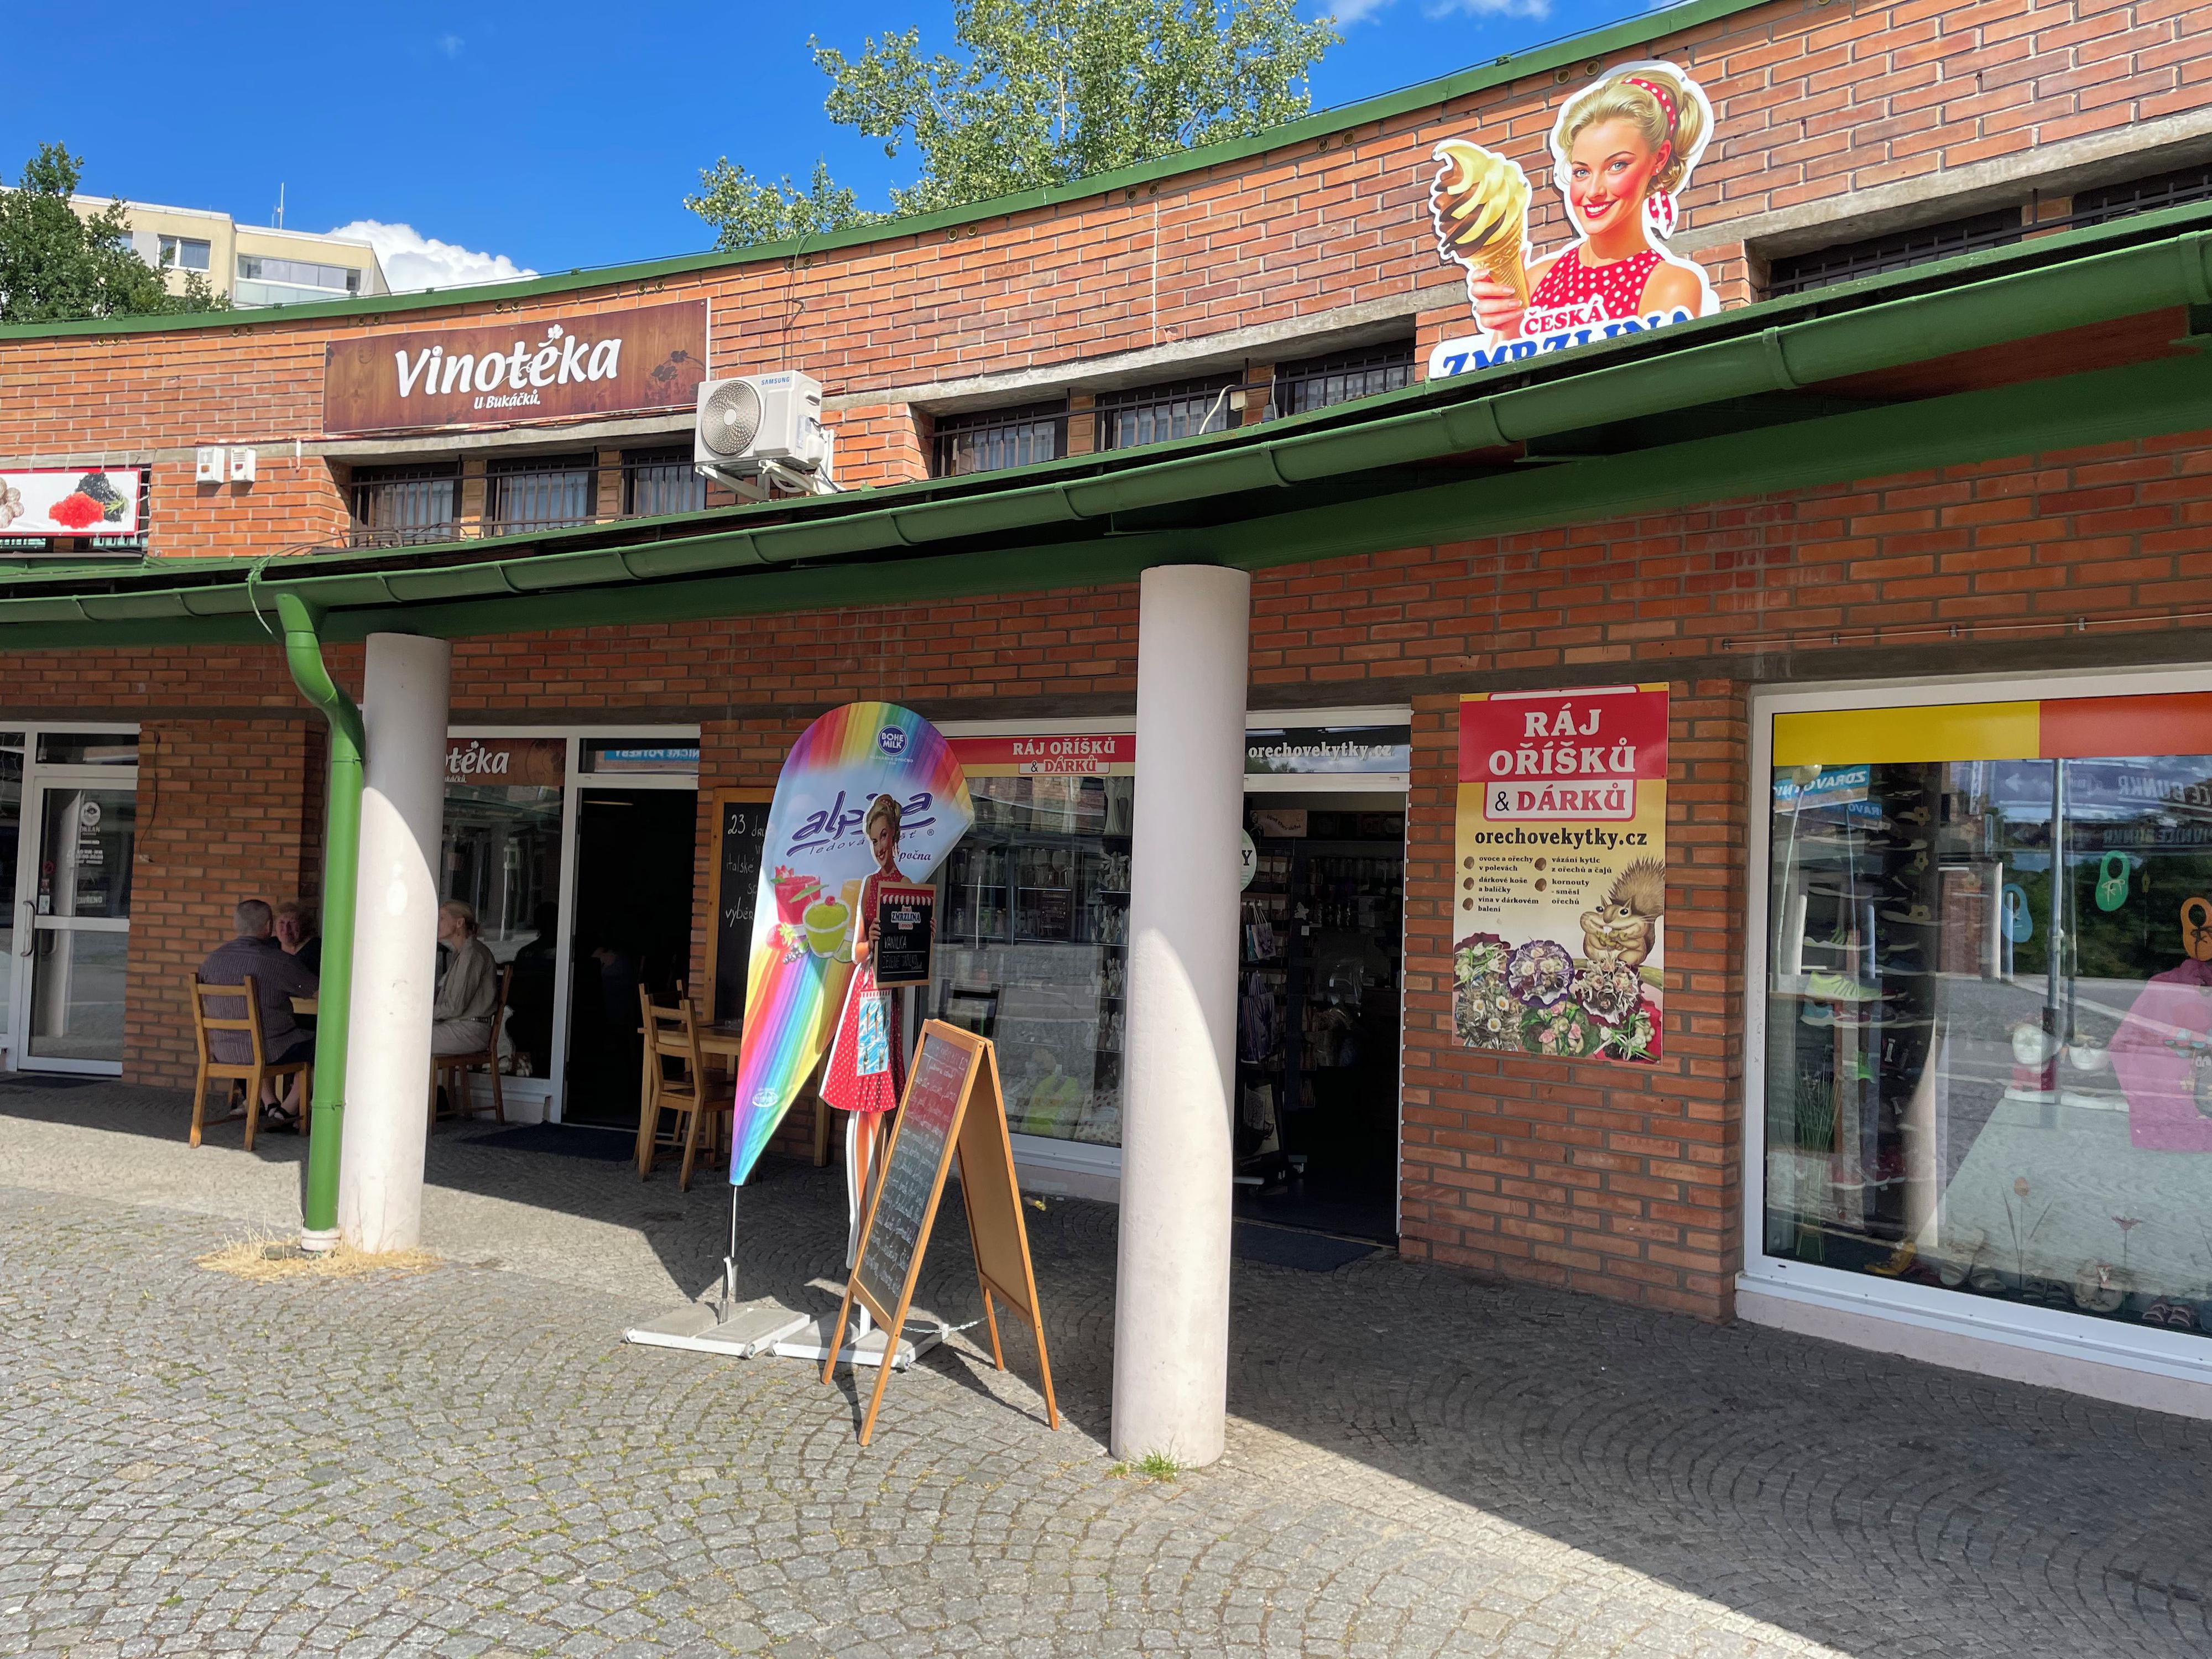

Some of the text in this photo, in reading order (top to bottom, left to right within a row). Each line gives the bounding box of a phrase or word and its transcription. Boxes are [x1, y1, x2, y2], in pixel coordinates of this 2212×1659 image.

[1524, 299, 1605, 335] ČESKÁ
[395, 324, 622, 397] Vinotéka
[761, 377, 790, 385] SAMSUNG
[1524, 702, 1601, 738] RÁJ
[881, 732, 904, 742] BOHE
[883, 740, 902, 749] MILK
[1013, 737, 1115, 755] RÁJ OŘÍŠKŮ
[1248, 741, 1392, 761] orechovekytky.cz
[1488, 737, 1636, 776] OŘÍŠKŮ
[1031, 755, 1097, 772] & DÁRKŮ
[1495, 783, 1626, 811] & DÁRKŮ
[728, 814, 746, 834] 23
[792, 790, 936, 843] alpa
[1475, 828, 1647, 850] orechovekytky.cz
[897, 850, 932, 863] počna
[892, 912, 920, 921] ZMRZLINA
[884, 936, 906, 950] VANILKA
